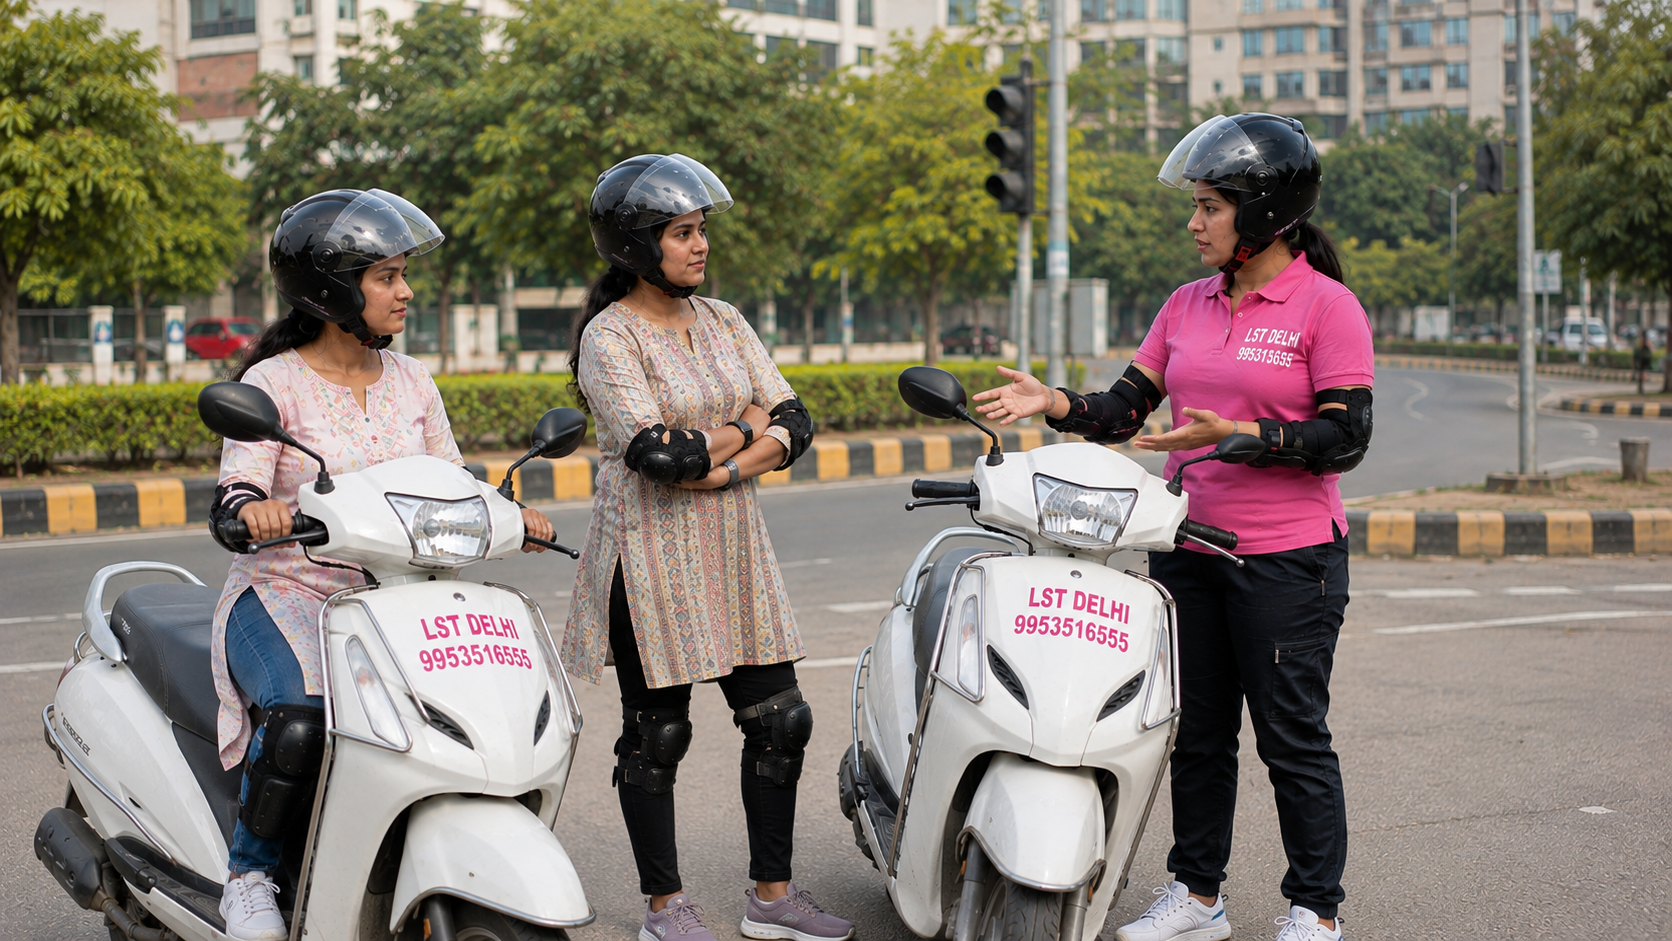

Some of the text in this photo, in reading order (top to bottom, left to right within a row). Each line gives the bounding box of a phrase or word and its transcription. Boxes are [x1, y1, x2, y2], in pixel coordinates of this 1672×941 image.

[1244, 327, 1301, 348] LST DELHI
[1028, 587, 1130, 625] LST DELHI
[420, 613, 520, 641] LST DELHI
[1013, 614, 1129, 653] 9953516555
[418, 644, 533, 672] 9953516555
